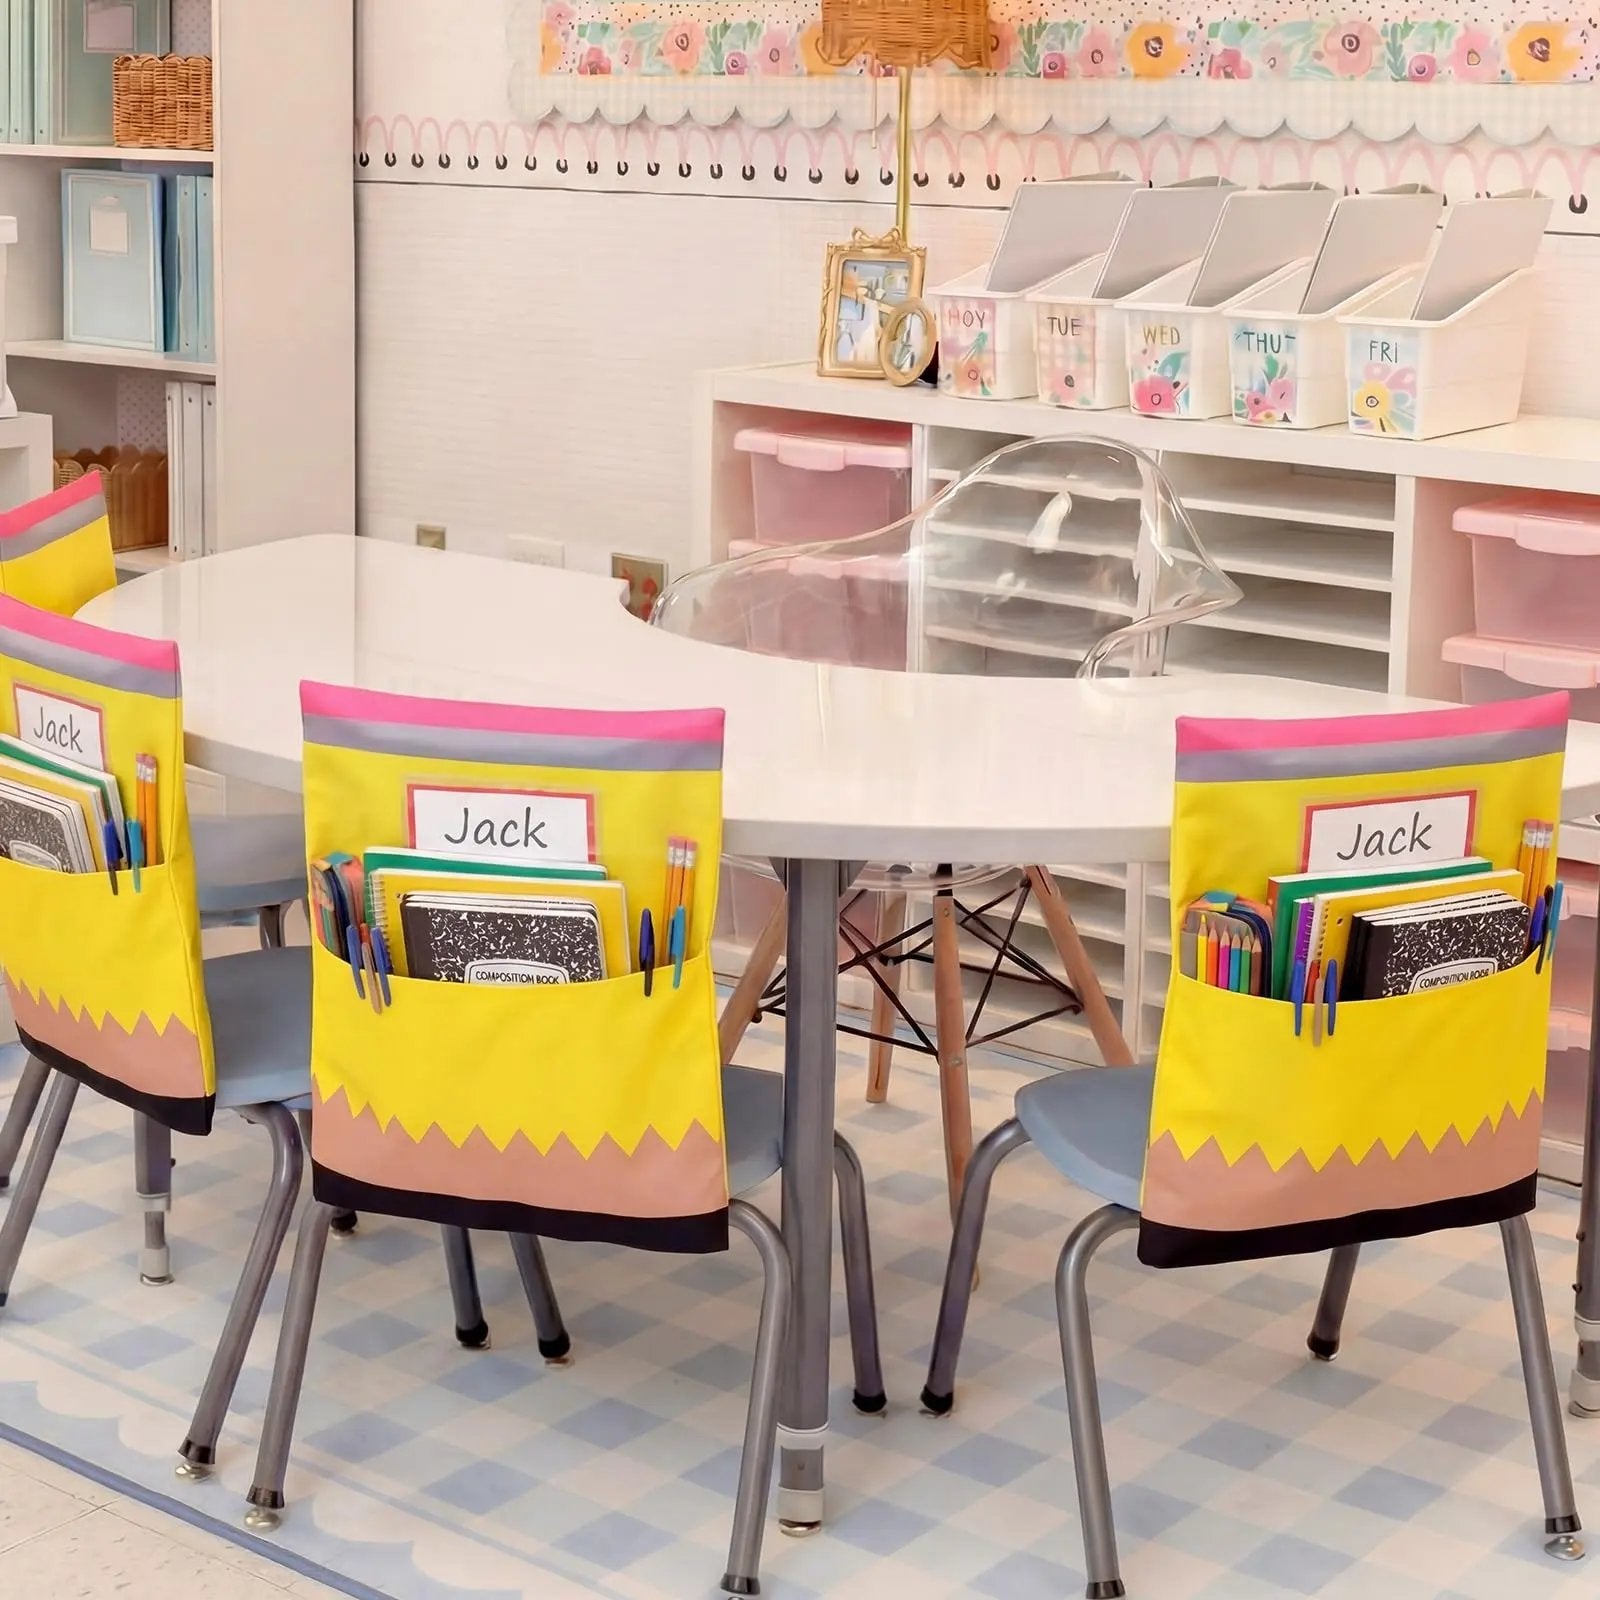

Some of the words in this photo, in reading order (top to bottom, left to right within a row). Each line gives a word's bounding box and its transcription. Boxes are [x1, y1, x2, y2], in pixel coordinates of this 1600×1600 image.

[1047, 317, 1082, 336] TUE
[1143, 326, 1181, 345] WED
[1369, 339, 1398, 364] FRI
[33, 706, 83, 754] Jack
[444, 806, 548, 849] Jack
[1336, 811, 1433, 861] Jack
[475, 970, 535, 985] COMPOSITION
